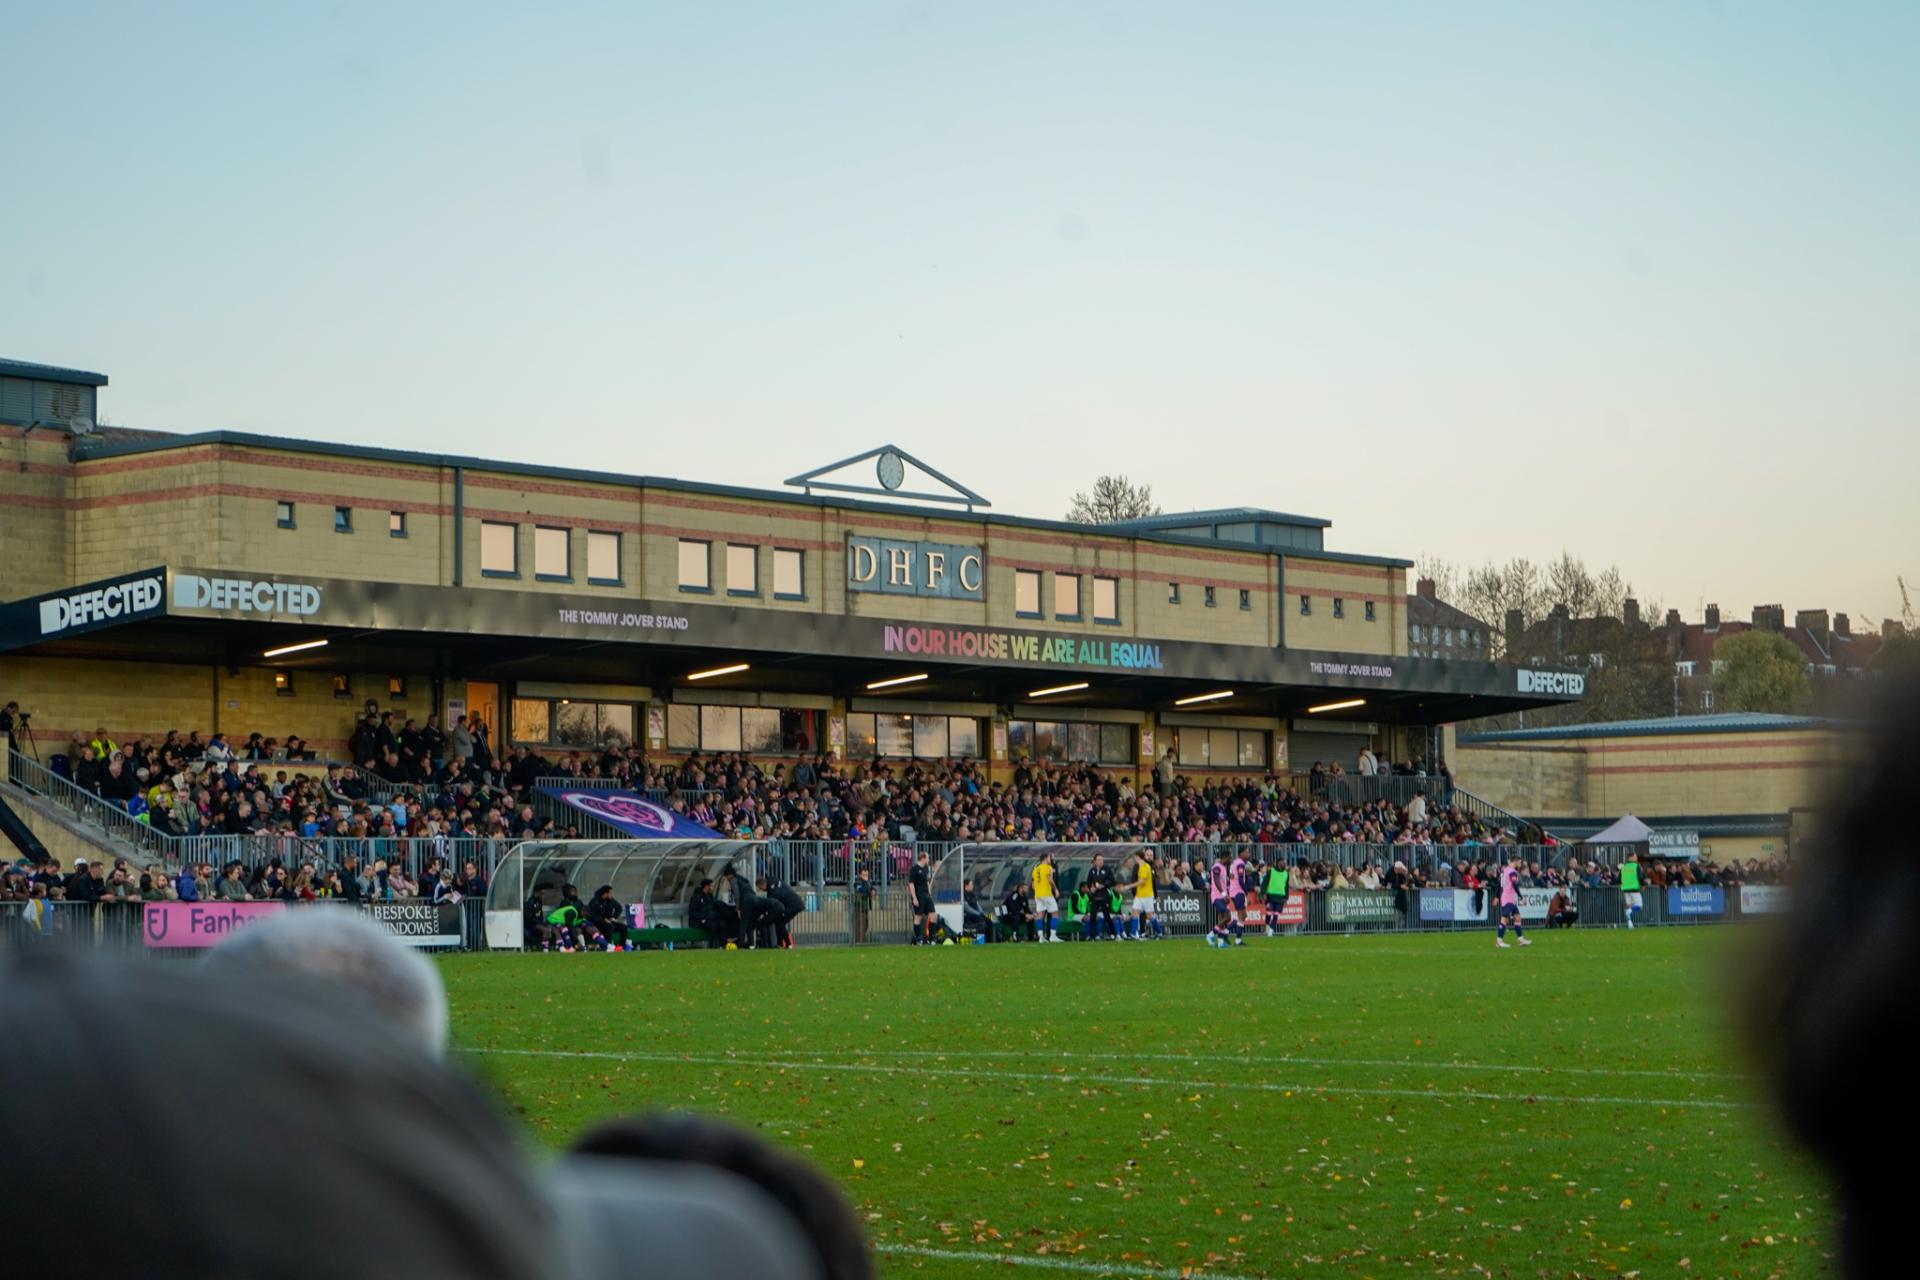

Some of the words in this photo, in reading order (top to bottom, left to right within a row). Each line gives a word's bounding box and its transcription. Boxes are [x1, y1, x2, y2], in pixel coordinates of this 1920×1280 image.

[173, 575, 321, 615] DEFECTED
[40, 577, 162, 634] DEFECTED
[559, 610, 578, 623] THE
[580, 611, 618, 626] TOMMY
[620, 613, 653, 628] JOVER
[655, 616, 689, 630] STAND
[884, 625, 904, 652] IN
[906, 627, 945, 655] OUR
[949, 631, 1009, 659] HOUSE
[1010, 635, 1039, 661] WE
[1041, 638, 1075, 664] ARE
[1078, 640, 1108, 667] ALL
[1110, 642, 1164, 669] EQUAL
[1310, 662, 1323, 673] THE
[1324, 663, 1348, 675] TOMMY
[1349, 664, 1370, 676] JOVER
[1371, 666, 1392, 677] STAND
[1517, 669, 1584, 694] DEFECTED
[1648, 833, 1675, 846] COME
[1686, 833, 1700, 846] GO
[374, 905, 432, 920] BESPOKE
[1164, 895, 1200, 912] rhodes
[1174, 911, 1200, 923] interiors
